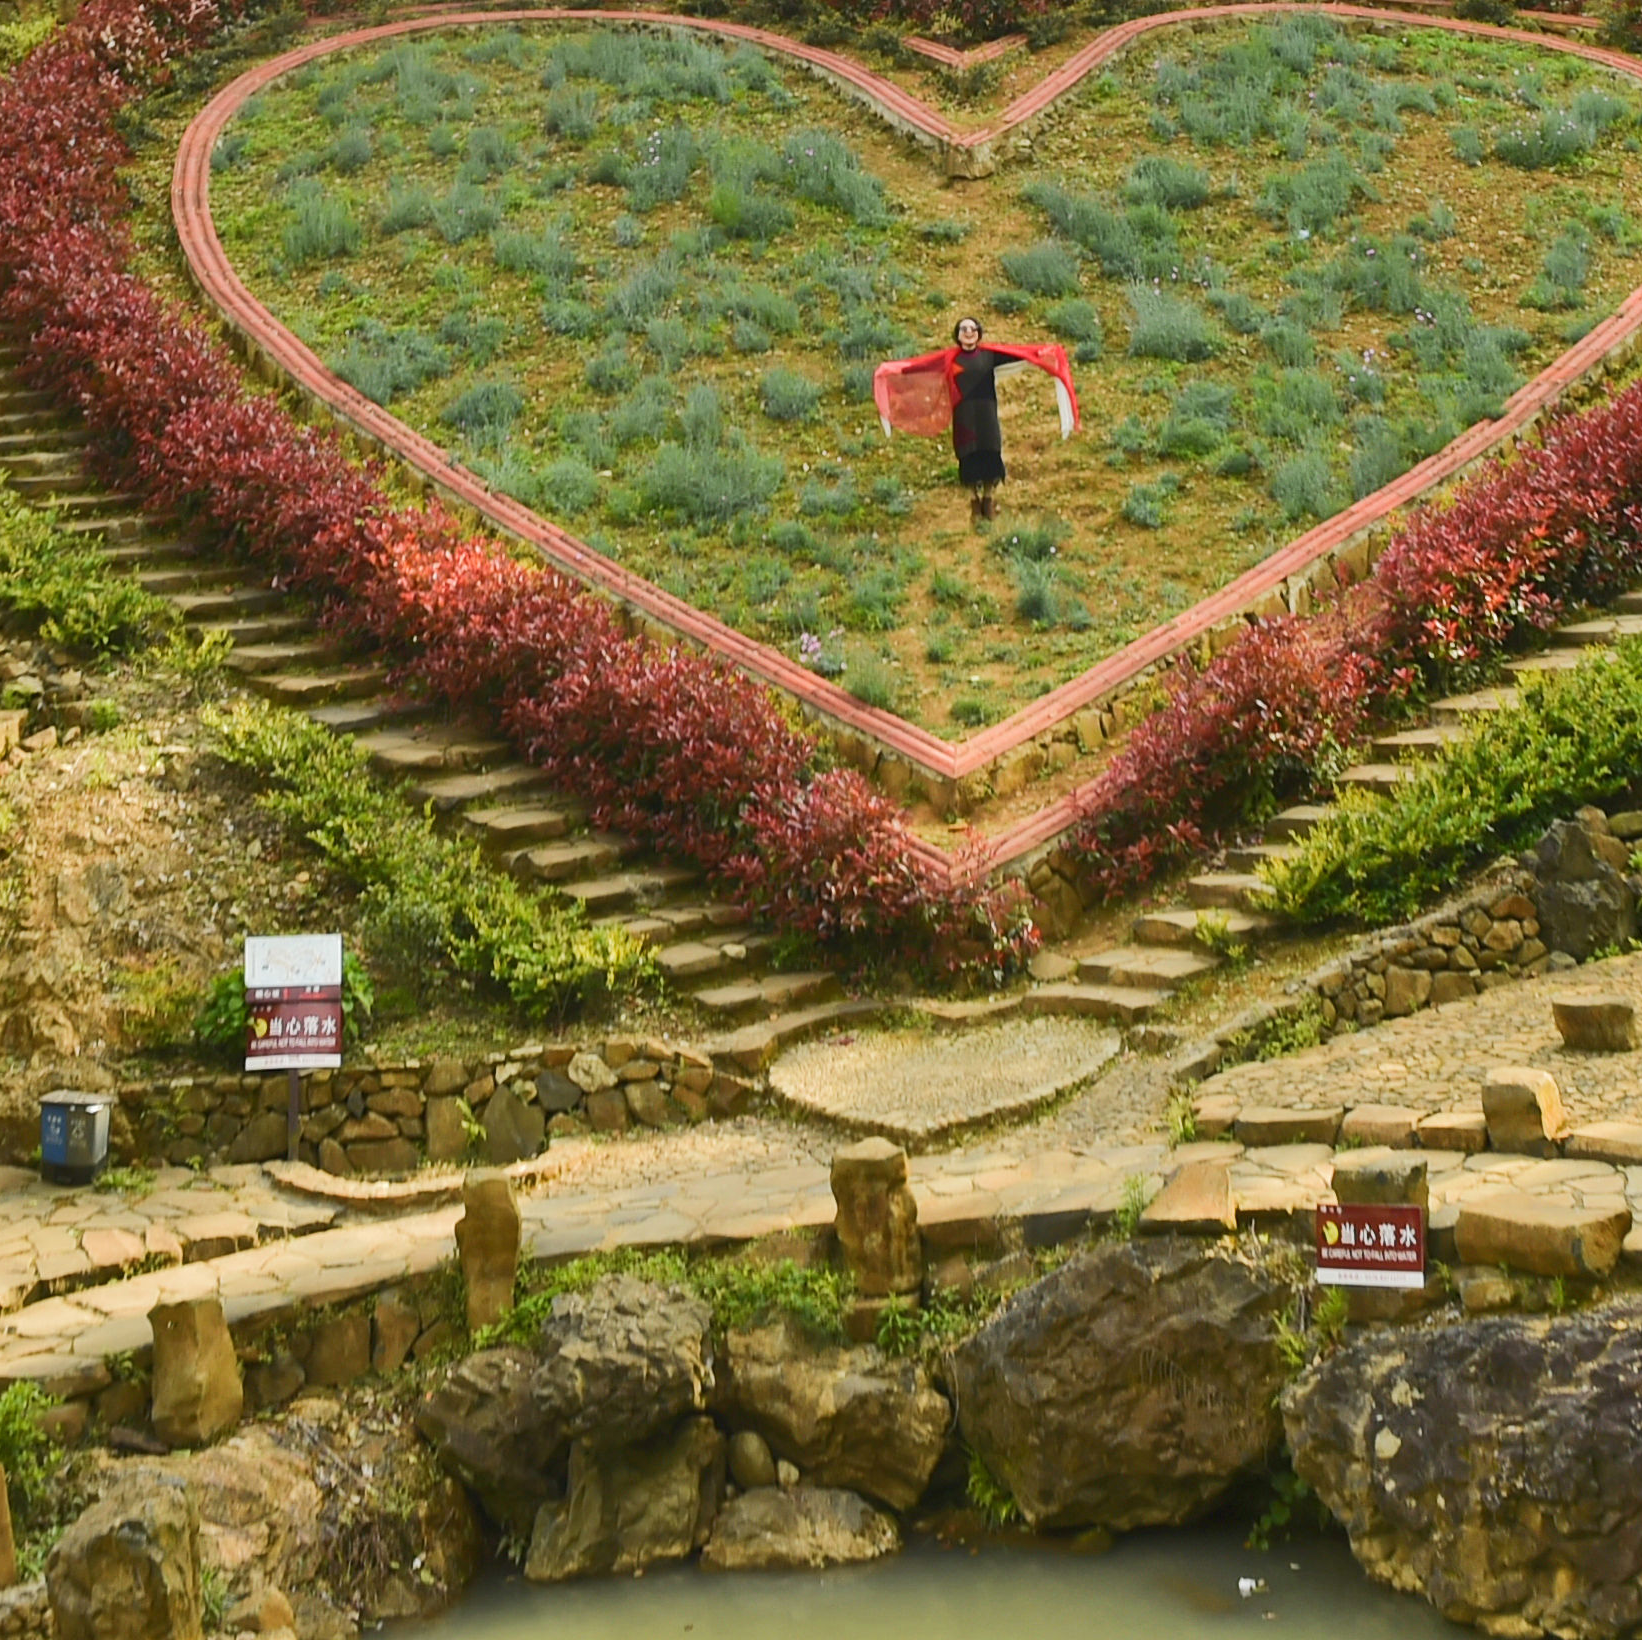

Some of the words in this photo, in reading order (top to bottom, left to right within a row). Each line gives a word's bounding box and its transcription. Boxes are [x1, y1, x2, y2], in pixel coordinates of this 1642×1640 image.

[269, 1015, 336, 1037] 当心落水
[1341, 1222, 1417, 1247] 当心落水
[1352, 1248, 1362, 1260] NOT
